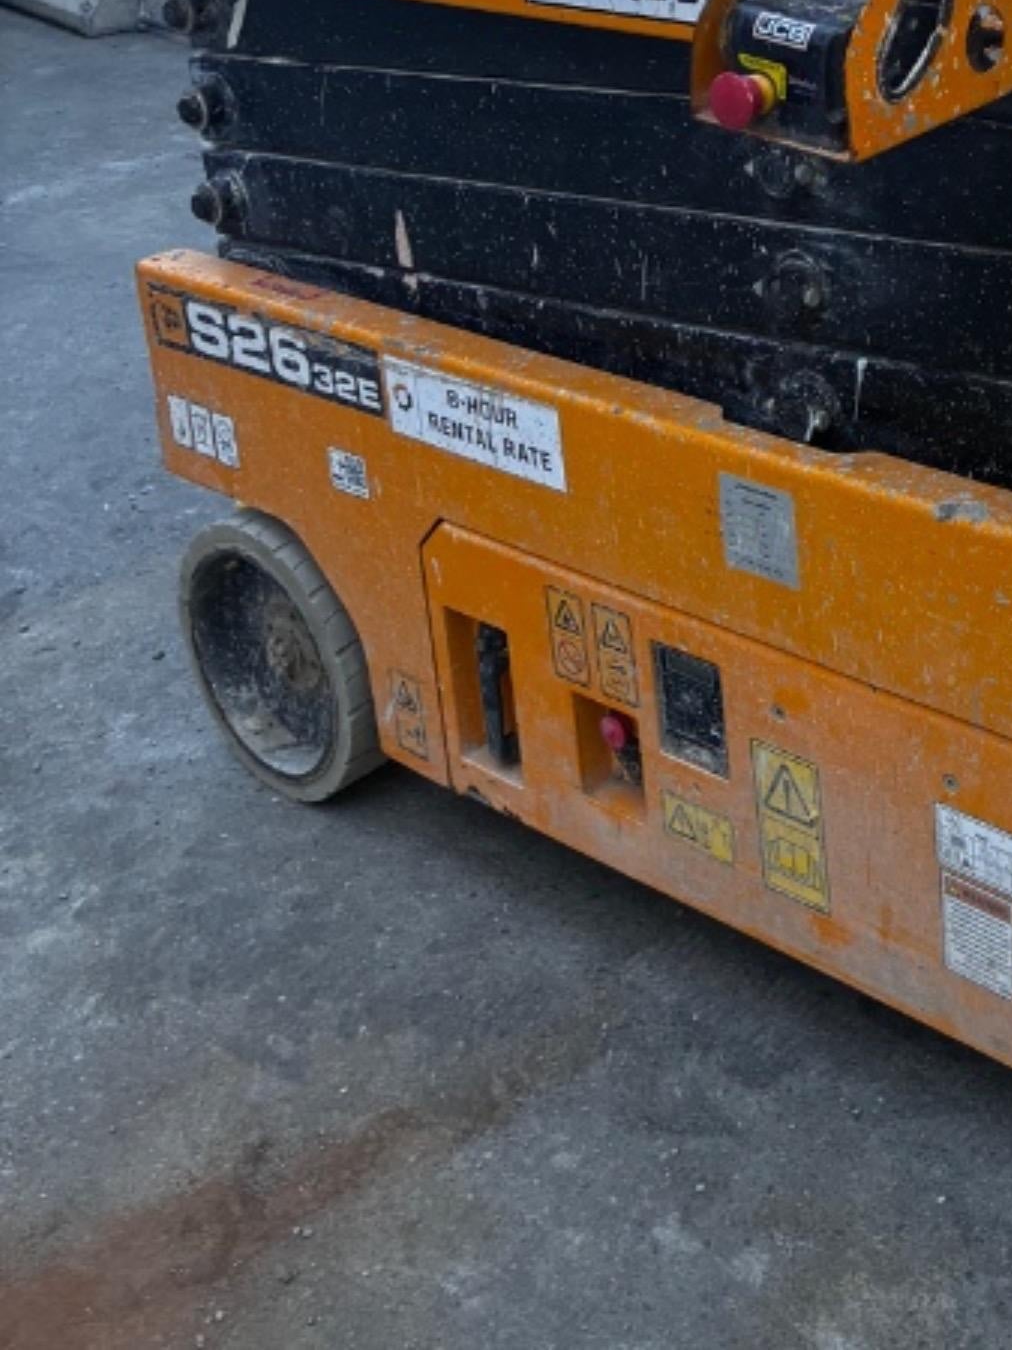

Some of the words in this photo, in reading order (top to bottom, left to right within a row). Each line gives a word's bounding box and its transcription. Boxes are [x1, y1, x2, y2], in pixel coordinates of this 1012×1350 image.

[757, 16, 808, 45] JCB
[186, 300, 310, 386] S26
[311, 361, 383, 411] 32E
[428, 410, 497, 454] RENTAL
[503, 436, 553, 472] RATE
